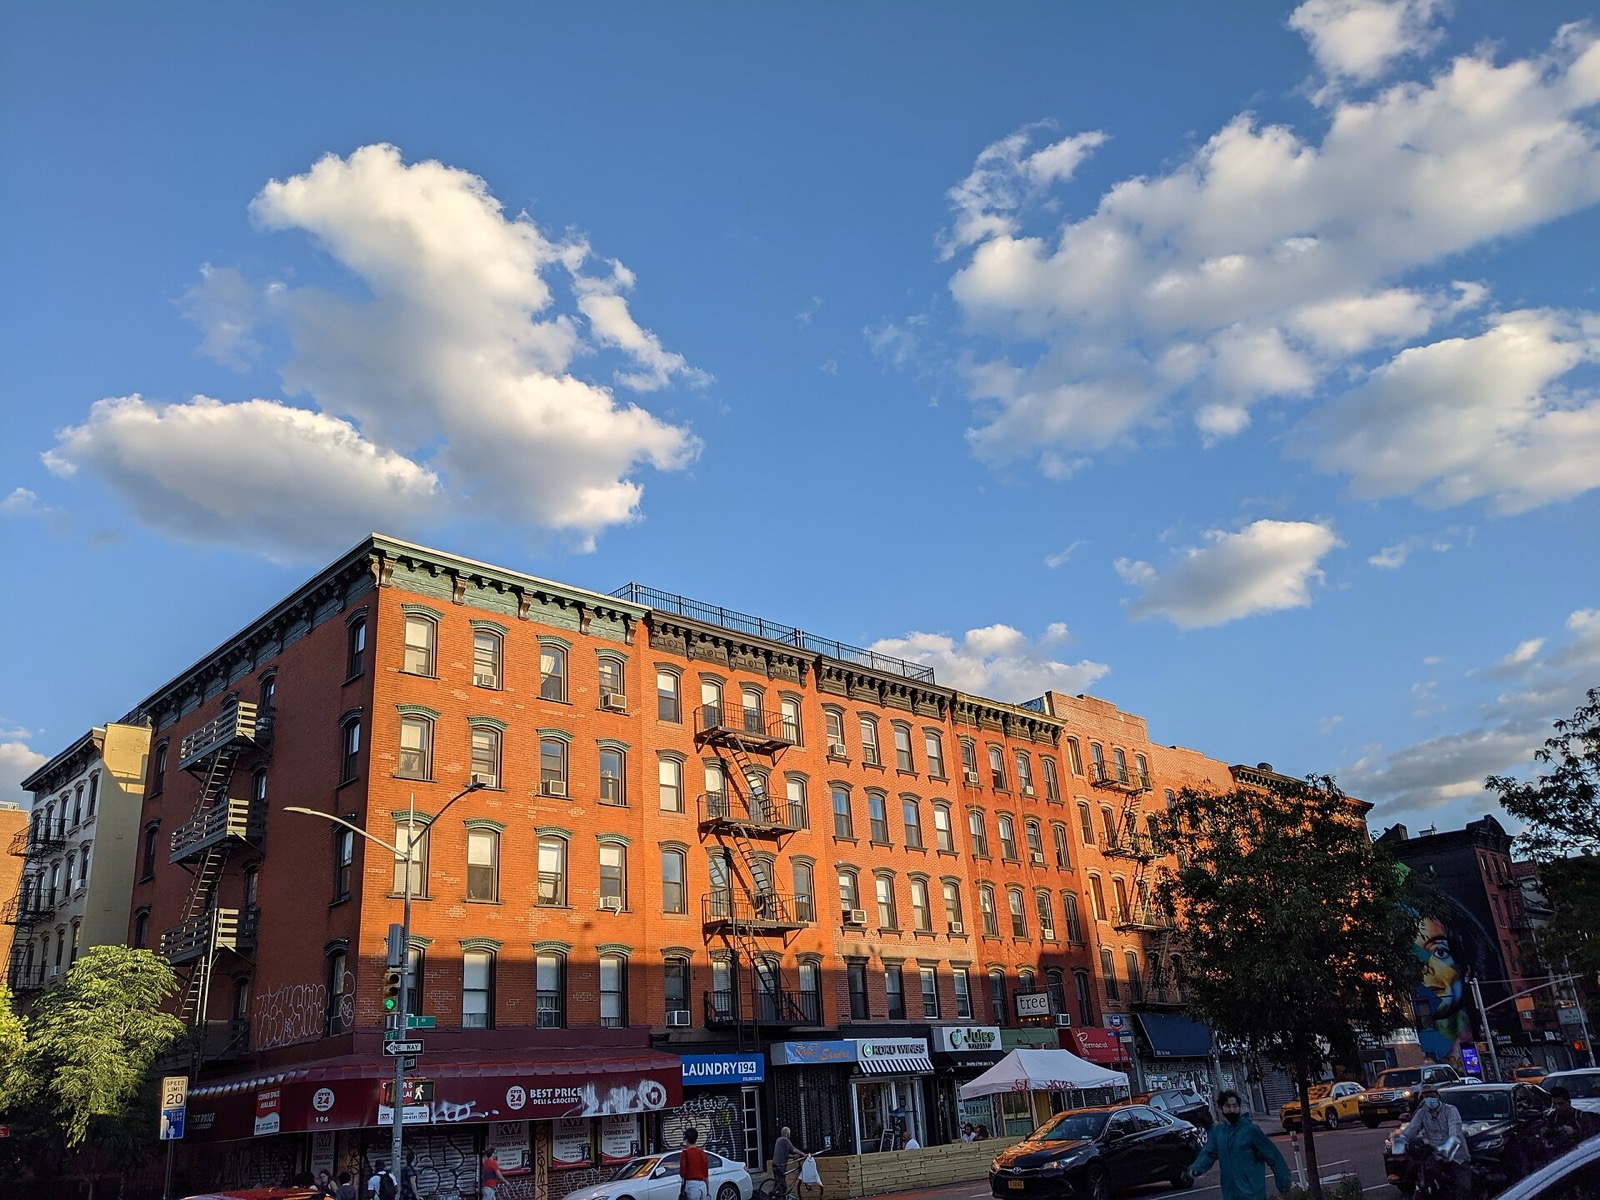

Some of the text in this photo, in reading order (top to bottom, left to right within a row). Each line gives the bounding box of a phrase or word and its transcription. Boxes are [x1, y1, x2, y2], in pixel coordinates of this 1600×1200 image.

[1020, 996, 1047, 1010] tree
[964, 1028, 996, 1043] Juice
[872, 1043, 925, 1056] KOKO WINGS
[682, 1062, 755, 1077] LAUNDRY 194
[510, 1094, 522, 1102] 24
[530, 1087, 582, 1098] BEST PRICE
[166, 1093, 184, 1105] 20
[260, 1099, 277, 1109] AVAILABLE
[317, 1097, 330, 1105] 24
[561, 1117, 582, 1126] KW
[609, 1114, 629, 1123] KW
[497, 1123, 521, 1134] KW
[317, 1134, 331, 1147] KW
